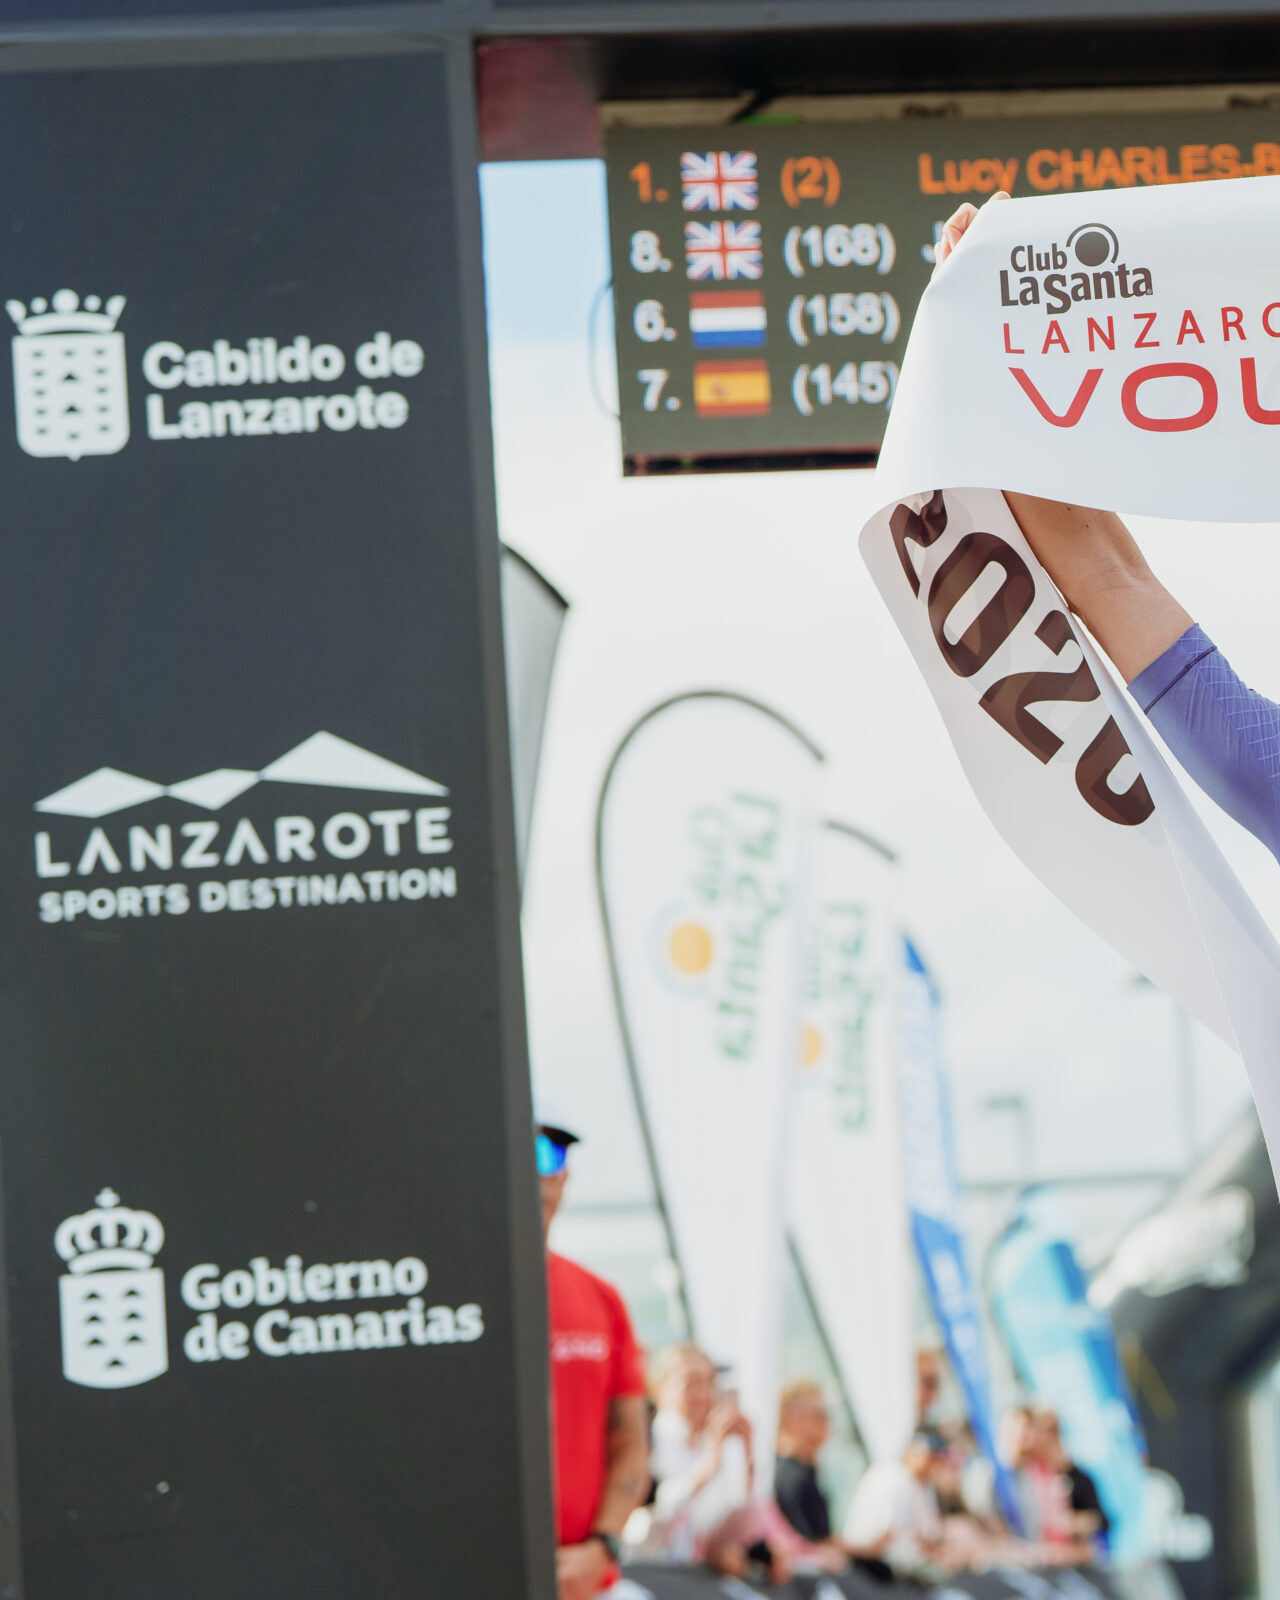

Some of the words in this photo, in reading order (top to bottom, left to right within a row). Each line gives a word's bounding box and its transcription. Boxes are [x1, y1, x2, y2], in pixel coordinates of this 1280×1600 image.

[629, 162, 669, 203] 1.
[781, 156, 841, 207] (2)
[918, 153, 1018, 196] Lucy
[630, 230, 673, 273] 8.
[783, 222, 896, 277] (168)
[1010, 243, 1067, 272] Club
[633, 299, 676, 342] 6.
[787, 292, 900, 346] (158)
[143, 335, 346, 389] Cabildo
[355, 332, 424, 378] de
[146, 387, 409, 440] Lanzarote
[637, 369, 681, 412] 7.
[35, 806, 454, 878] LANZAROTE
[39, 883, 190, 924] SPORTS
[199, 868, 456, 913] DESTINATION
[181, 1254, 428, 1311] Gobierno
[183, 1313, 250, 1362] de
[254, 1297, 485, 1357] Canarias
